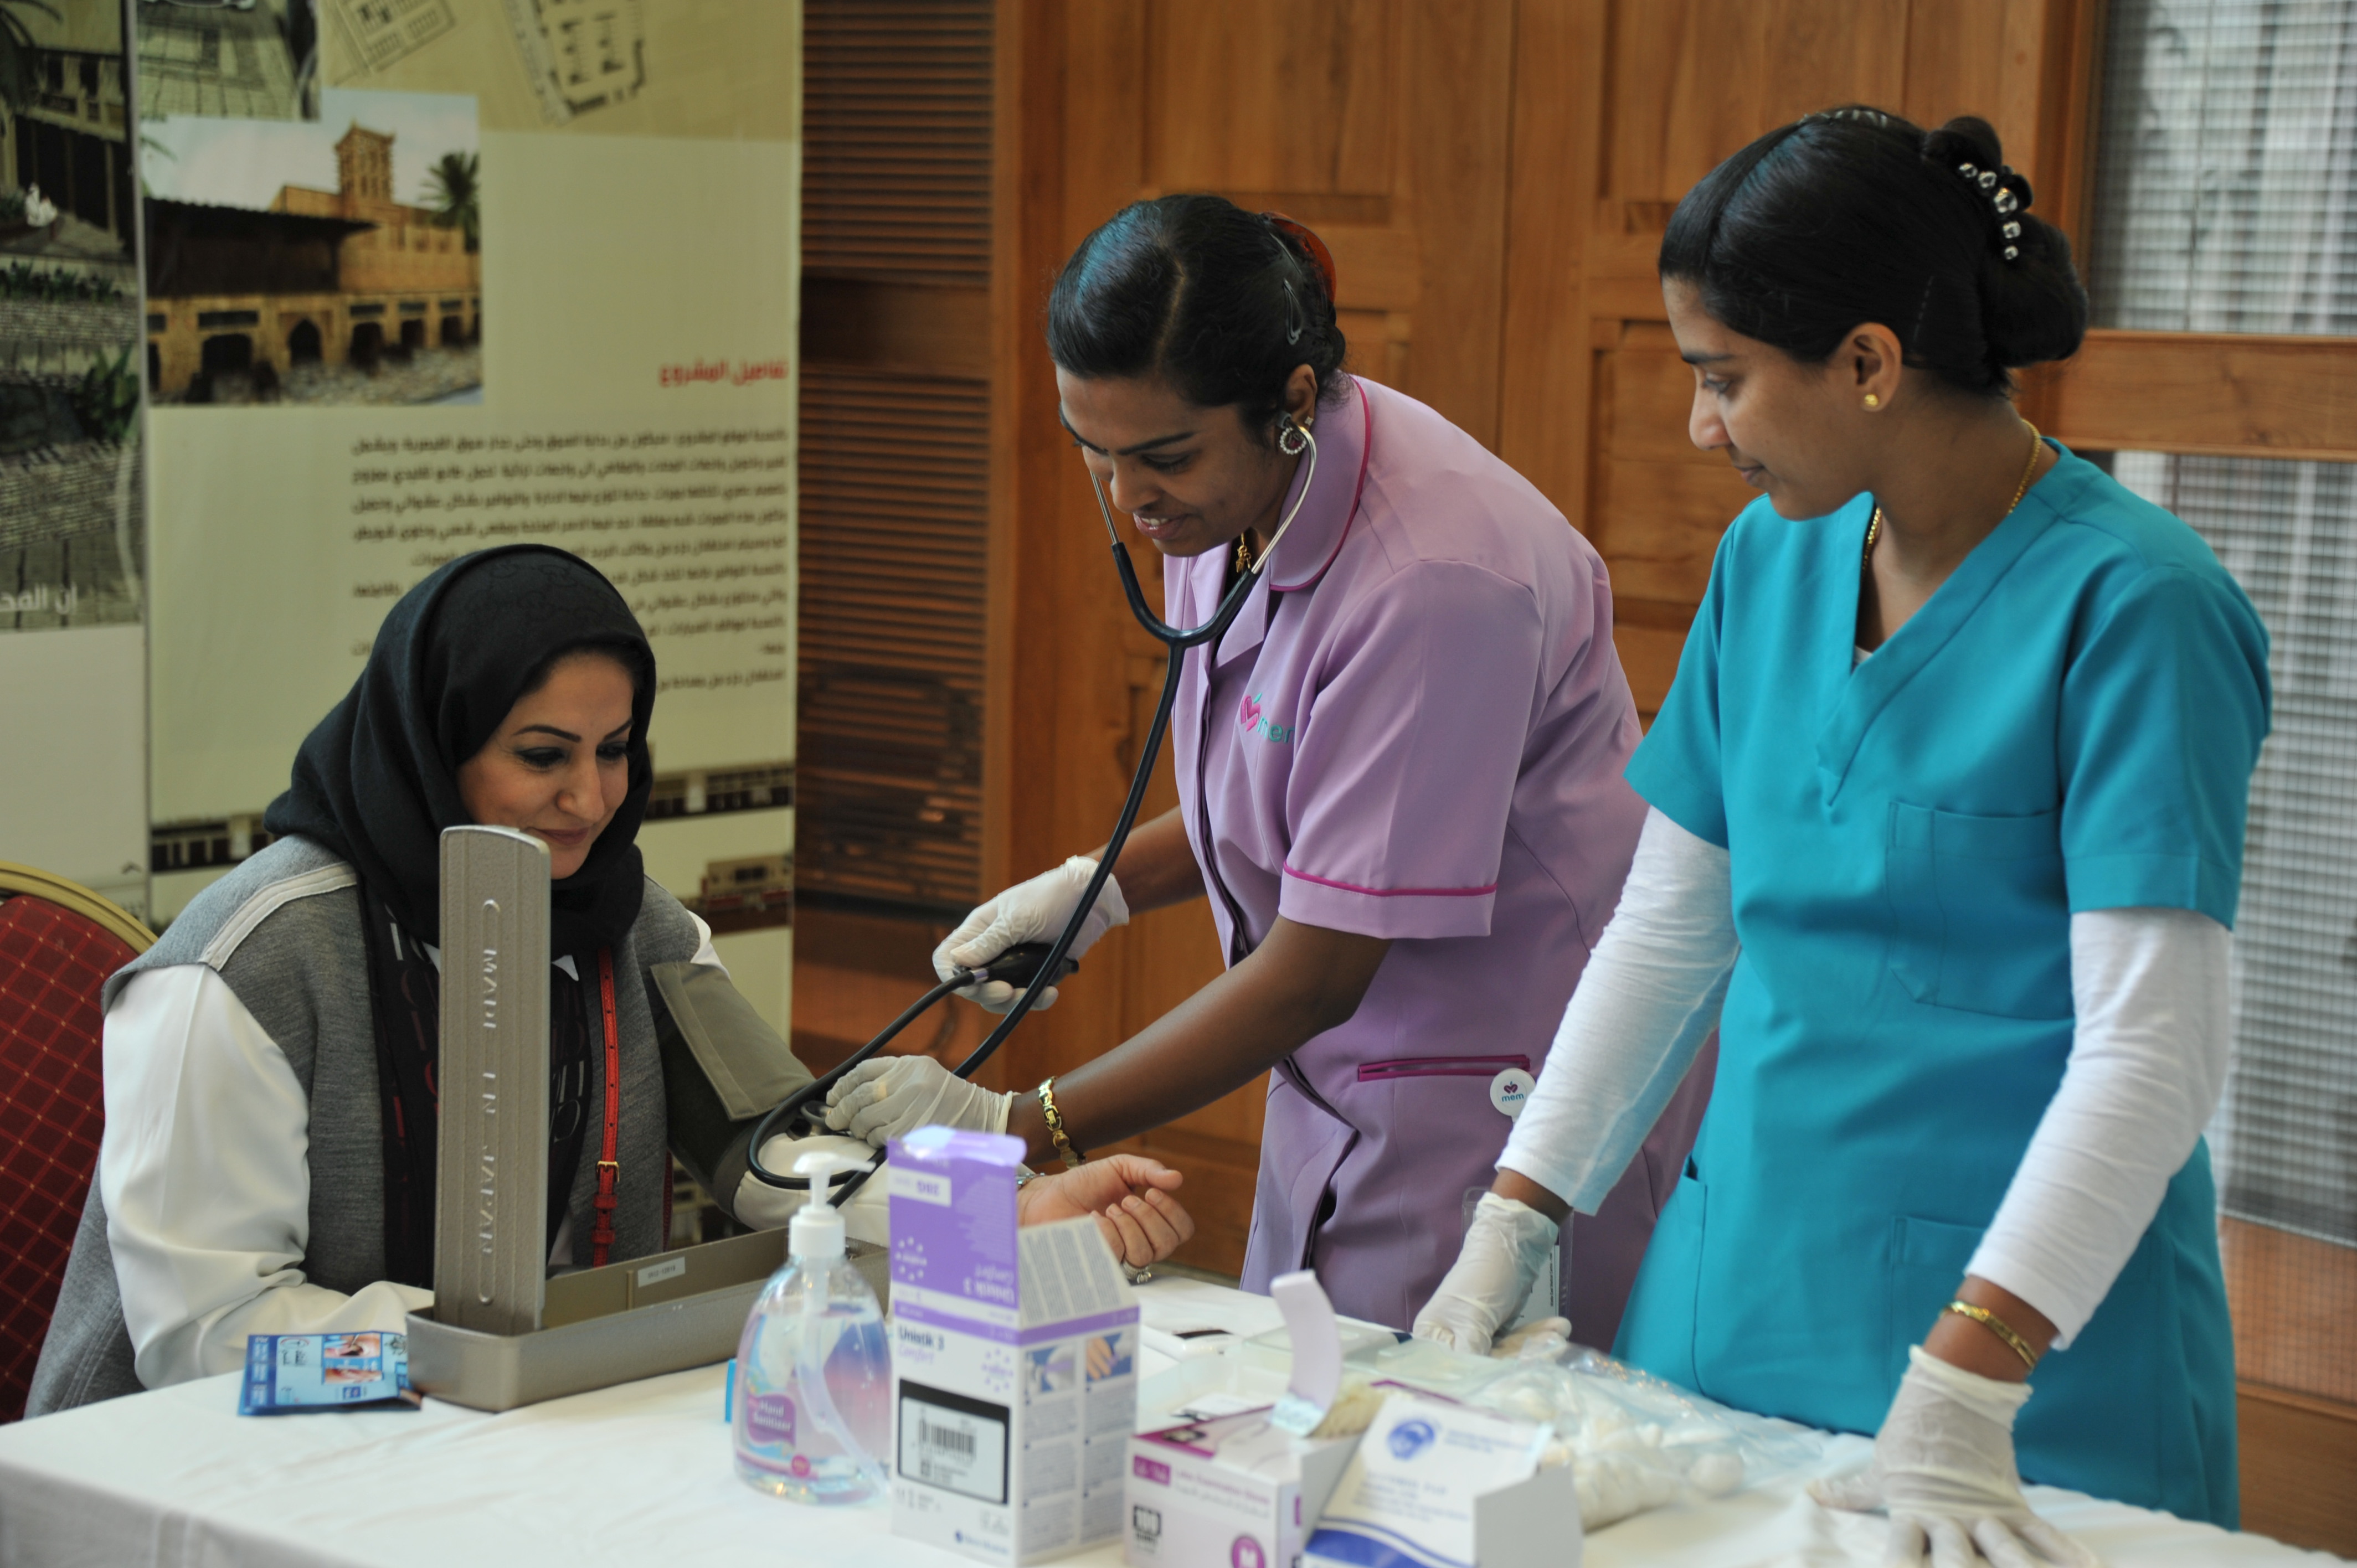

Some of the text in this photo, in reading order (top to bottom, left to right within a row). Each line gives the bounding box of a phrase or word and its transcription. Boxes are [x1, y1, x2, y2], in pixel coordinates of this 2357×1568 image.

[660, 357, 788, 388] تفاصيل المشروع
[478, 947, 498, 1255] MADE IN JAPAN
[1501, 1093, 1524, 1102] mem
[899, 1325, 945, 1352] Unistik 3
[898, 1344, 935, 1363] Comfort
[760, 1400, 785, 1418] Hand
[752, 1411, 792, 1432] Sanitizer
